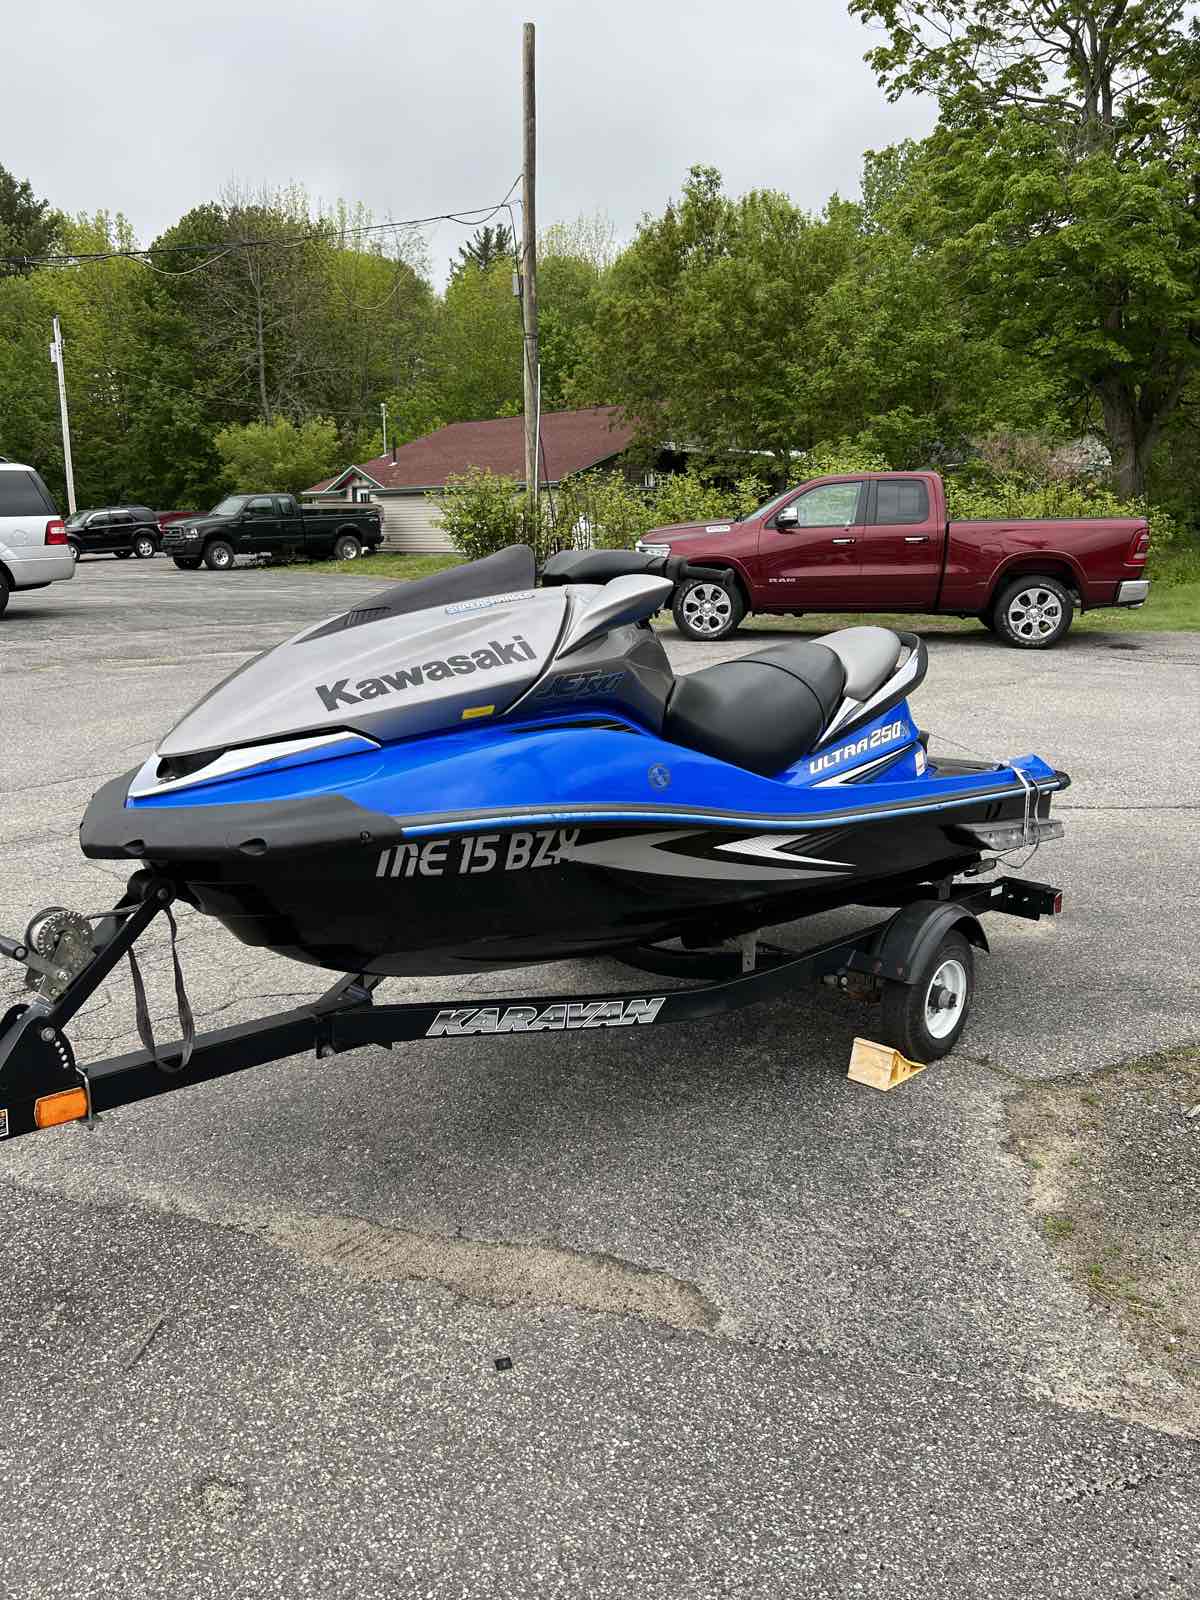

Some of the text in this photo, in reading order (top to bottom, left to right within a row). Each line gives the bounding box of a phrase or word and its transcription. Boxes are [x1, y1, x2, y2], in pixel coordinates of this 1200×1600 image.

[315, 635, 537, 712] Kawasaki
[809, 738, 868, 774] ULTRA
[375, 839, 450, 878] ME
[458, 834, 500, 874] 15
[425, 997, 667, 1037] KARAVAN
